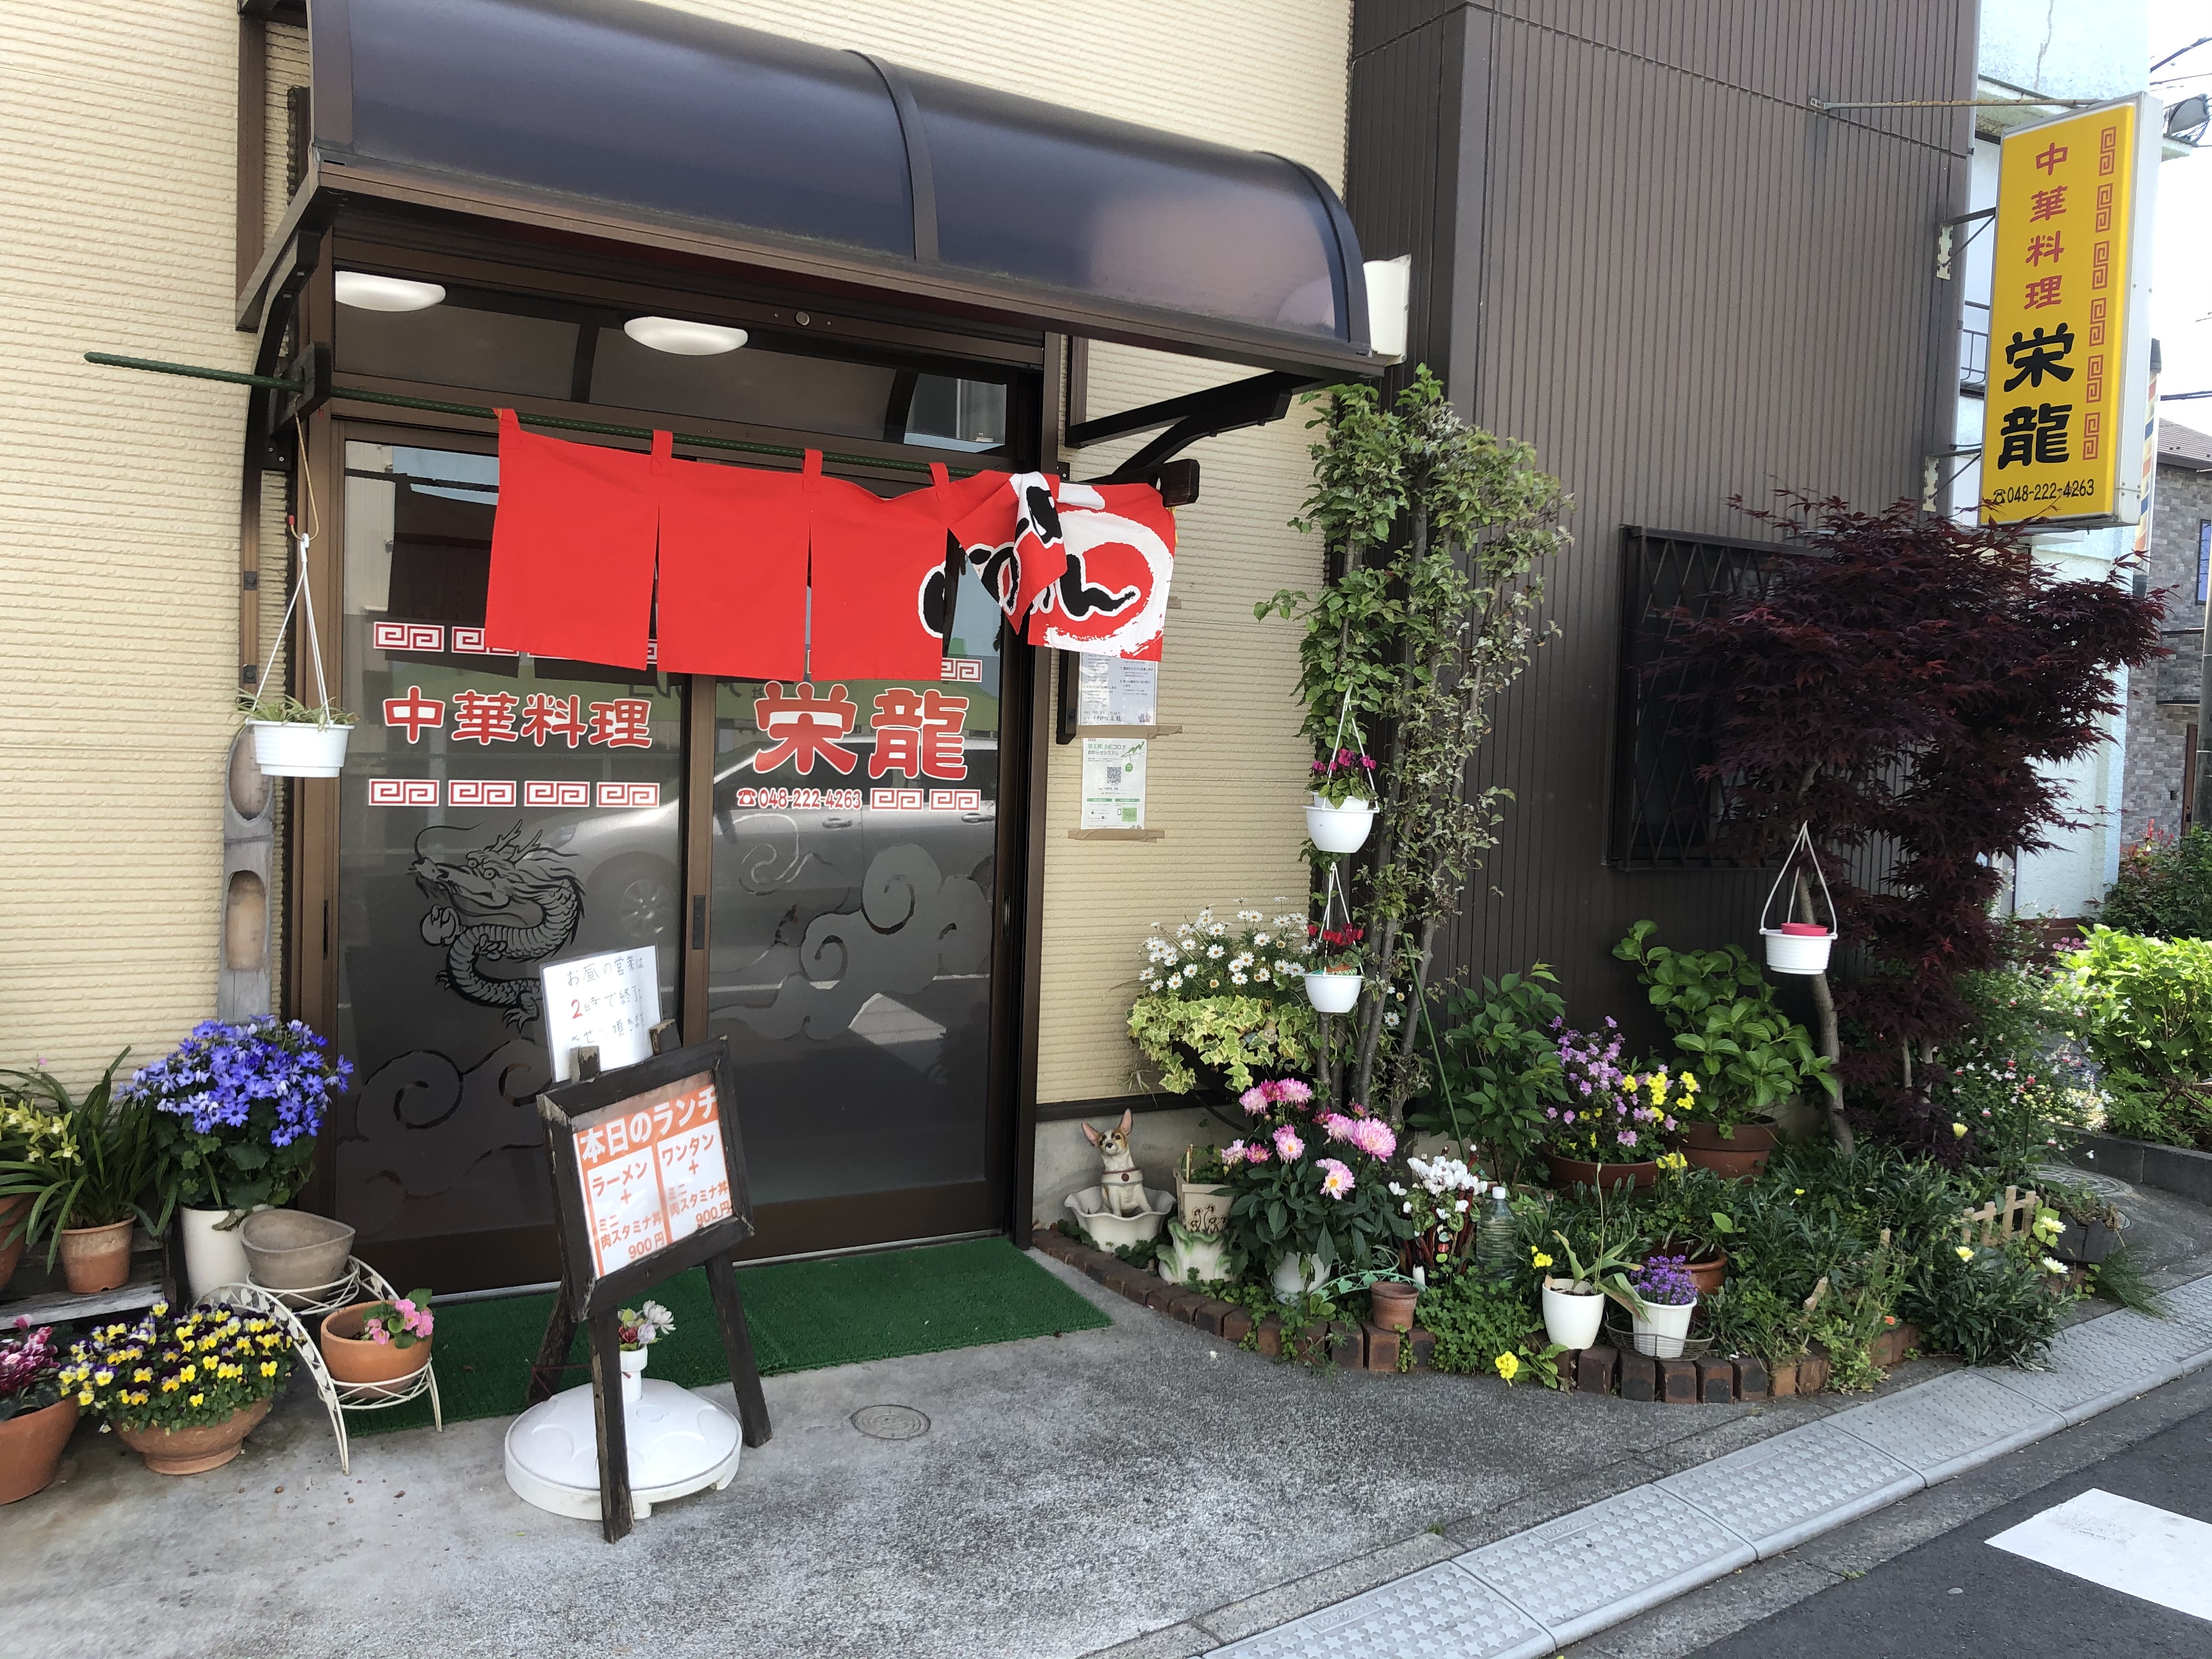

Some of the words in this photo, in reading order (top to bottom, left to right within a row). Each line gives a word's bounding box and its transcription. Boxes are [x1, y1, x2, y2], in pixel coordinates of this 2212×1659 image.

[2024, 142, 2069, 310] 中華料理
[1997, 321, 2075, 470] 栄龍
[2007, 478, 2094, 504] 048-222-4263
[382, 685, 653, 749] 中華料理
[753, 680, 969, 781] 栄龍
[758, 787, 862, 811] 048-222-4263
[580, 1085, 717, 1163] 本日のランチ
[662, 1134, 714, 1166] ワンタン
[592, 1161, 647, 1197] ラーメン
[669, 1180, 729, 1218] 肉スタミナ丼
[695, 1200, 731, 1228] 900円
[599, 1214, 619, 1232] ミニ
[600, 1210, 663, 1250] 肉スタミナ丼
[628, 1231, 665, 1259] 900円
